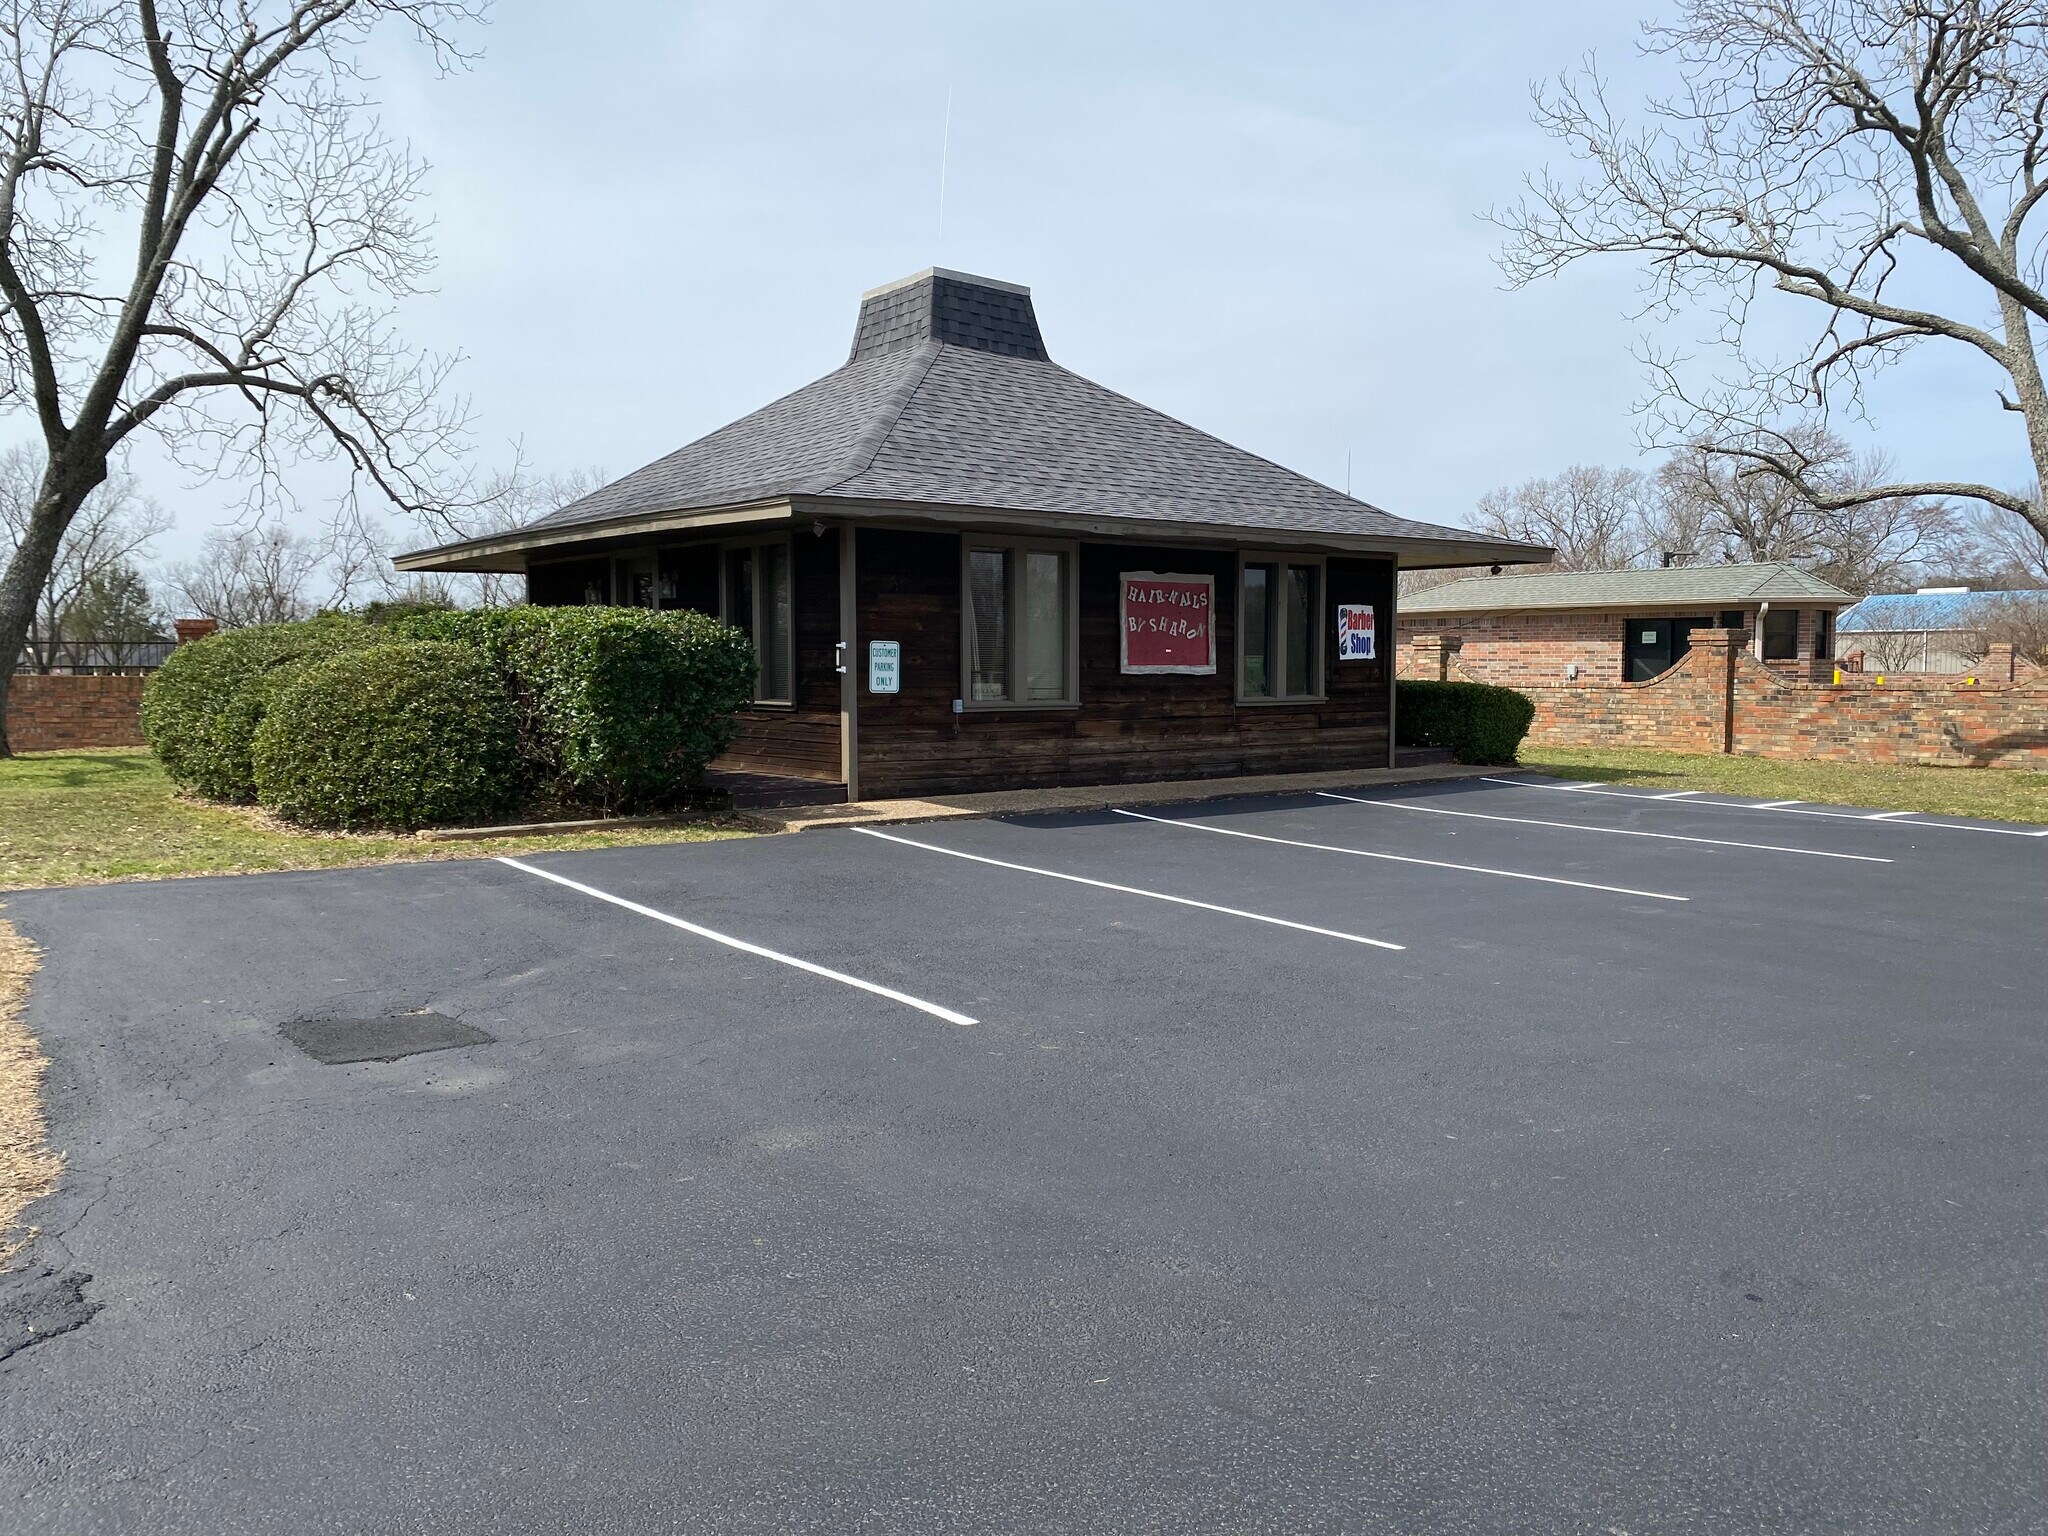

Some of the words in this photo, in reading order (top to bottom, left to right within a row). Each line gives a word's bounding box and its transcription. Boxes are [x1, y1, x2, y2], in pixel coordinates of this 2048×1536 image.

[1128, 586, 1208, 610] HAIR-NAILS
[1128, 616, 1146, 633] BY
[1149, 616, 1206, 640] SHARON
[1347, 609, 1374, 631] Barber
[873, 648, 897, 657] CUSTOMER
[1351, 633, 1371, 655] Shop
[875, 662, 894, 671] PARKING
[876, 677, 893, 686] ONLY
